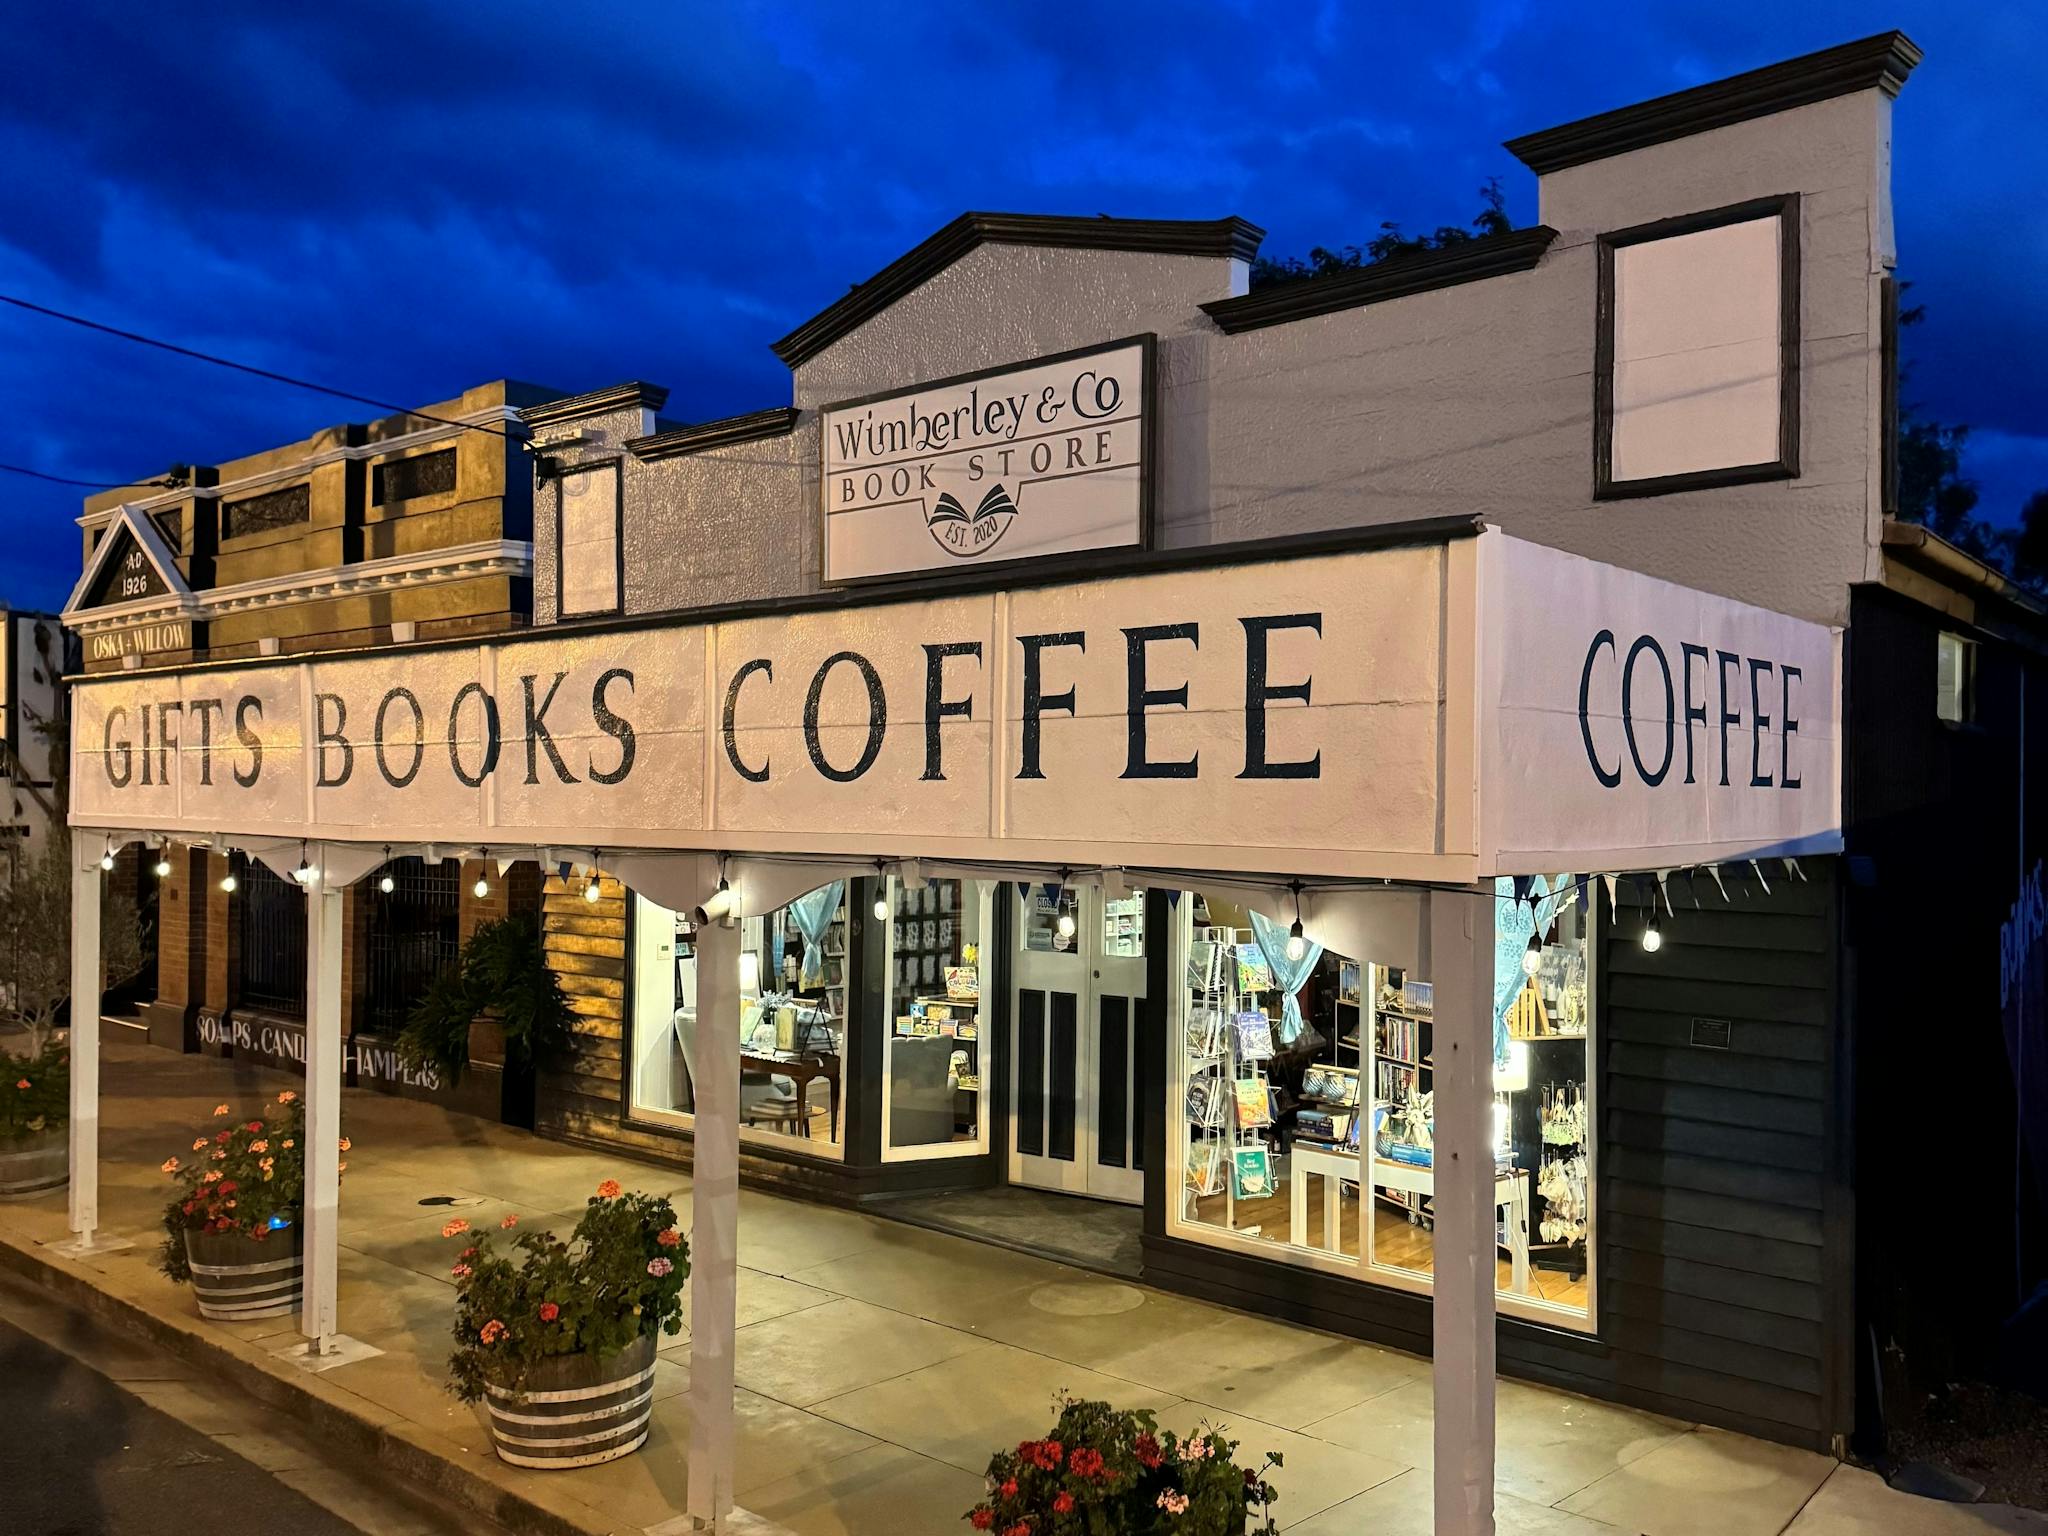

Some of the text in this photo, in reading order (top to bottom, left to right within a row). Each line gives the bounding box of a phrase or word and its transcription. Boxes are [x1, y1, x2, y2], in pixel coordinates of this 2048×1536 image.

[834, 369, 1124, 460] Wimberley & Co
[841, 430, 1112, 503] BOOK STORE
[945, 516, 998, 547] EST. 2020
[122, 575, 147, 596] 1926
[93, 633, 124, 659] OSKA
[133, 623, 187, 653] WILLOW
[104, 694, 263, 788] GIFTS
[315, 668, 636, 788] BOOKS
[723, 612, 1323, 783] COFFEE
[1578, 629, 1802, 788] COFFEE
